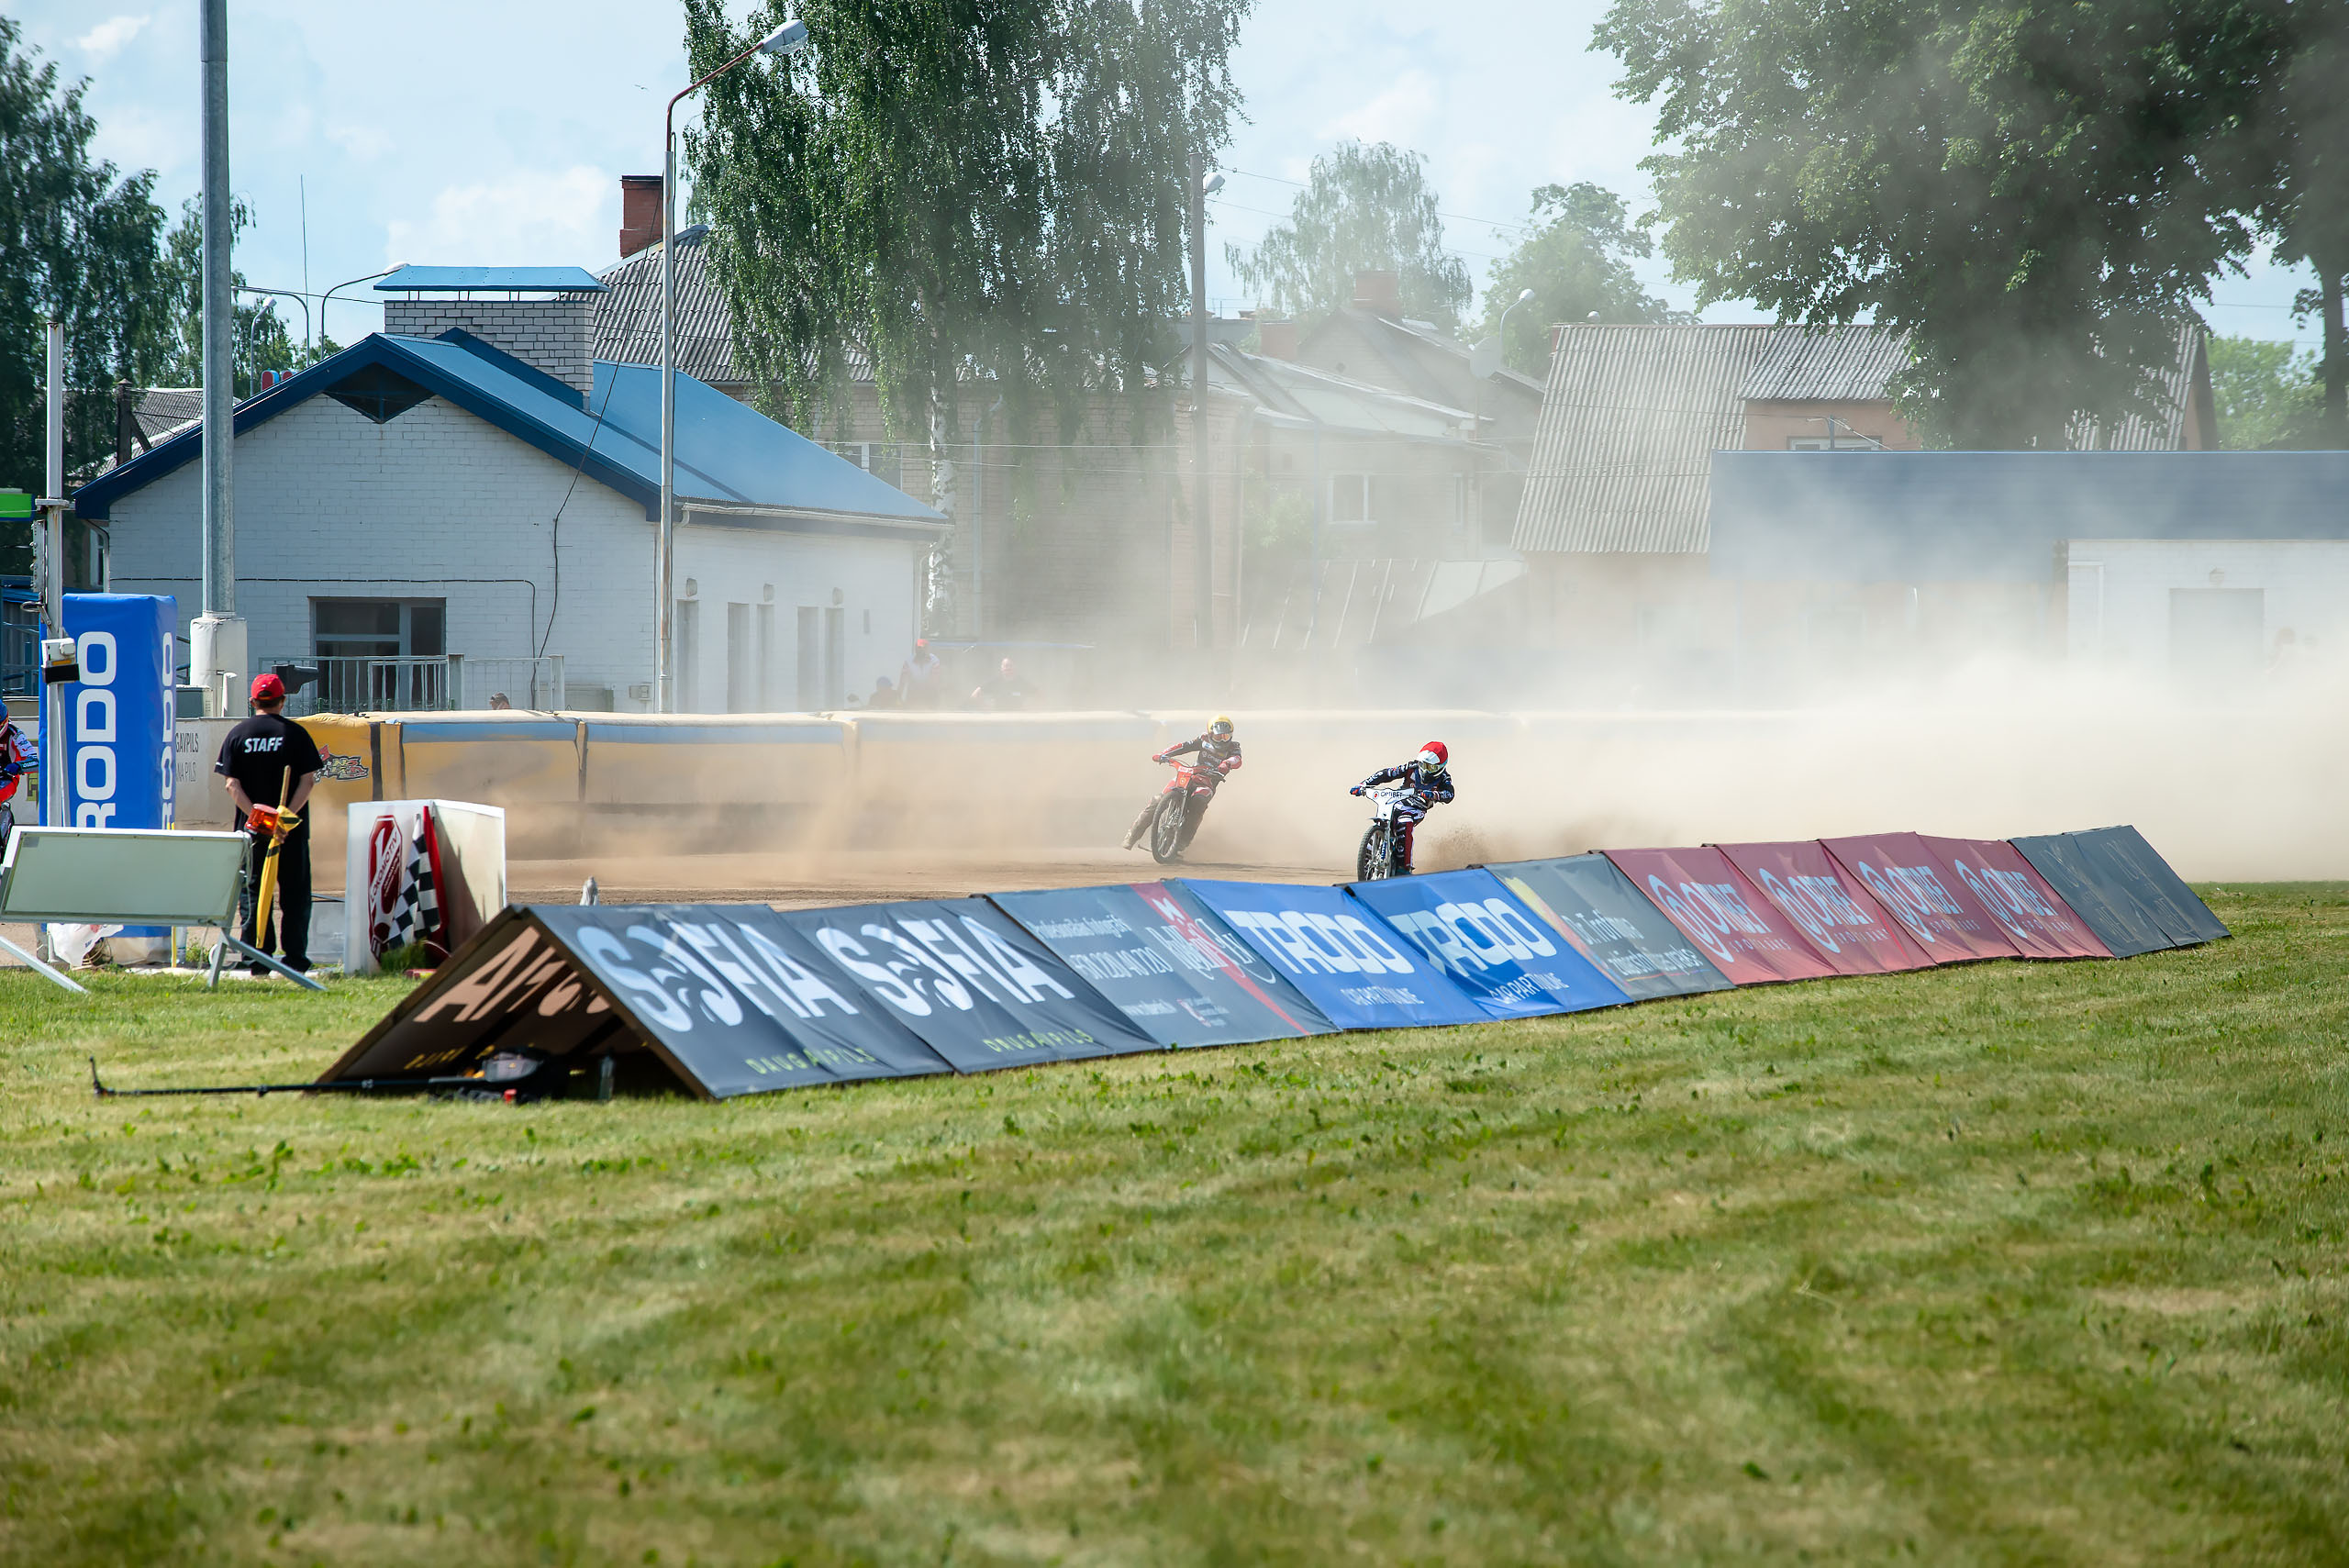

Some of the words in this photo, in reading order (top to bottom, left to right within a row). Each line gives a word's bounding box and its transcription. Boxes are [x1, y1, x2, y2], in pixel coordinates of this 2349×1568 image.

[244, 737, 284, 753] STAFF
[371, 831, 398, 903] LOKOMOTIV
[817, 917, 1074, 1017] SOFIA
[1223, 909, 1415, 974] TRODO
[1386, 898, 1558, 977] TRODO
[577, 921, 859, 1031] SOFIA
